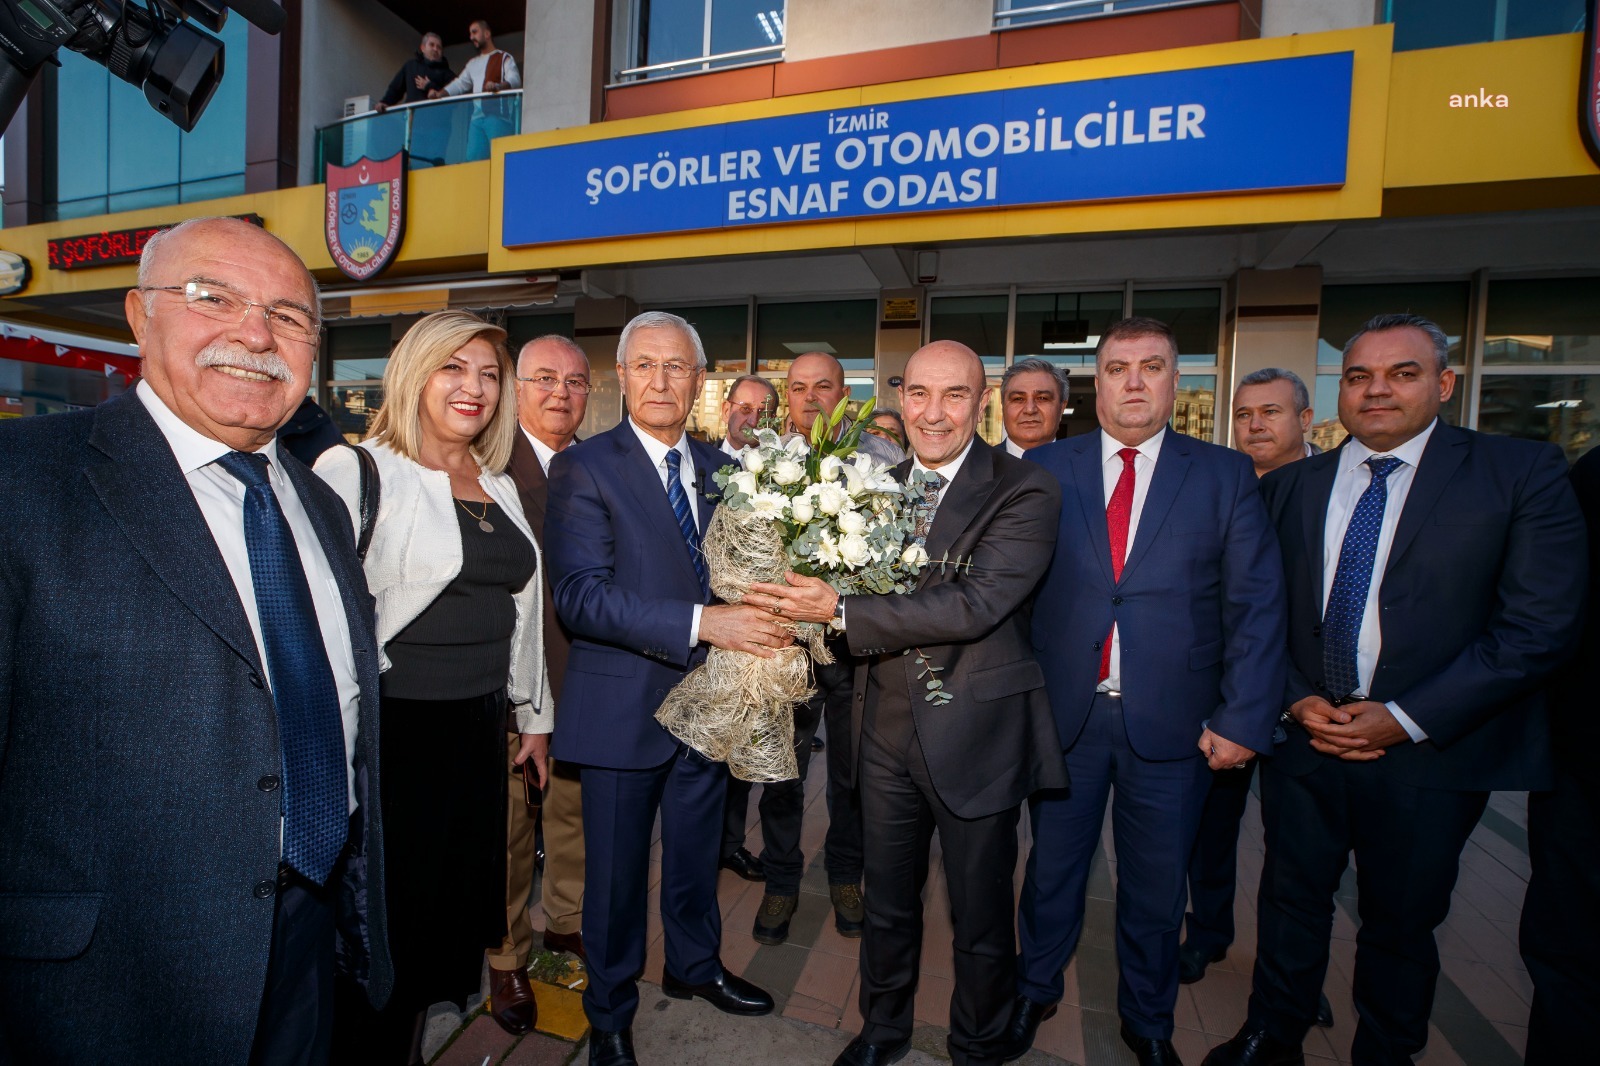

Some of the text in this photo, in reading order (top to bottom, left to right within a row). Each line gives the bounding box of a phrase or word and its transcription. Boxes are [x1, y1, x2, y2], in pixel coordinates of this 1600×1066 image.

[828, 107, 889, 134] İZMİR
[585, 100, 1206, 206] ŞOFÖRLER VE OTOMOBİLCİLER
[728, 167, 998, 221] ESNAF ODASI
